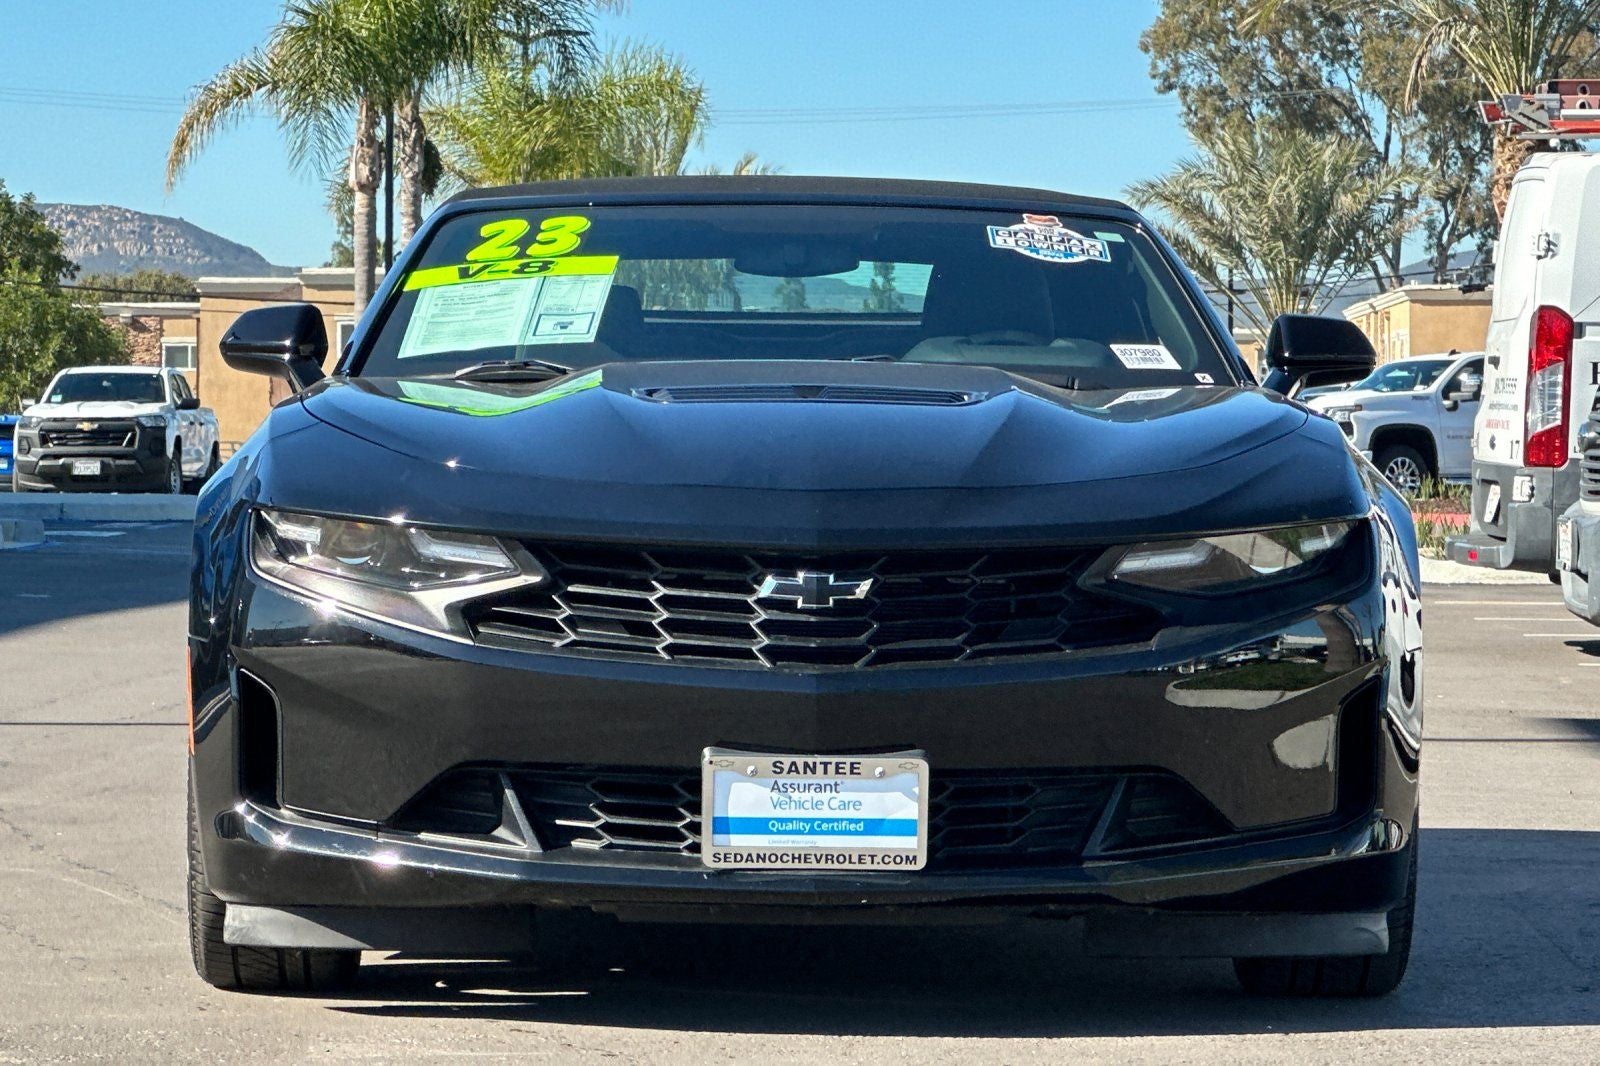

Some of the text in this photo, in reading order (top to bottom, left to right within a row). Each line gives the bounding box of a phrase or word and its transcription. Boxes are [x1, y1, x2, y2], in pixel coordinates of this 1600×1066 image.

[466, 216, 591, 261] 23
[997, 230, 1099, 250] CARFAX
[1017, 240, 1101, 257] OWNER
[457, 261, 558, 279] V-8
[1117, 348, 1161, 357] 307980
[1510, 439, 1520, 459] 17
[771, 760, 862, 776] SANTEE
[769, 780, 841, 794] Assurant
[770, 796, 863, 811] Vehicle Care
[768, 820, 864, 833] Quality Certified
[712, 852, 918, 866] SEDANOCHEVROLET.COM
